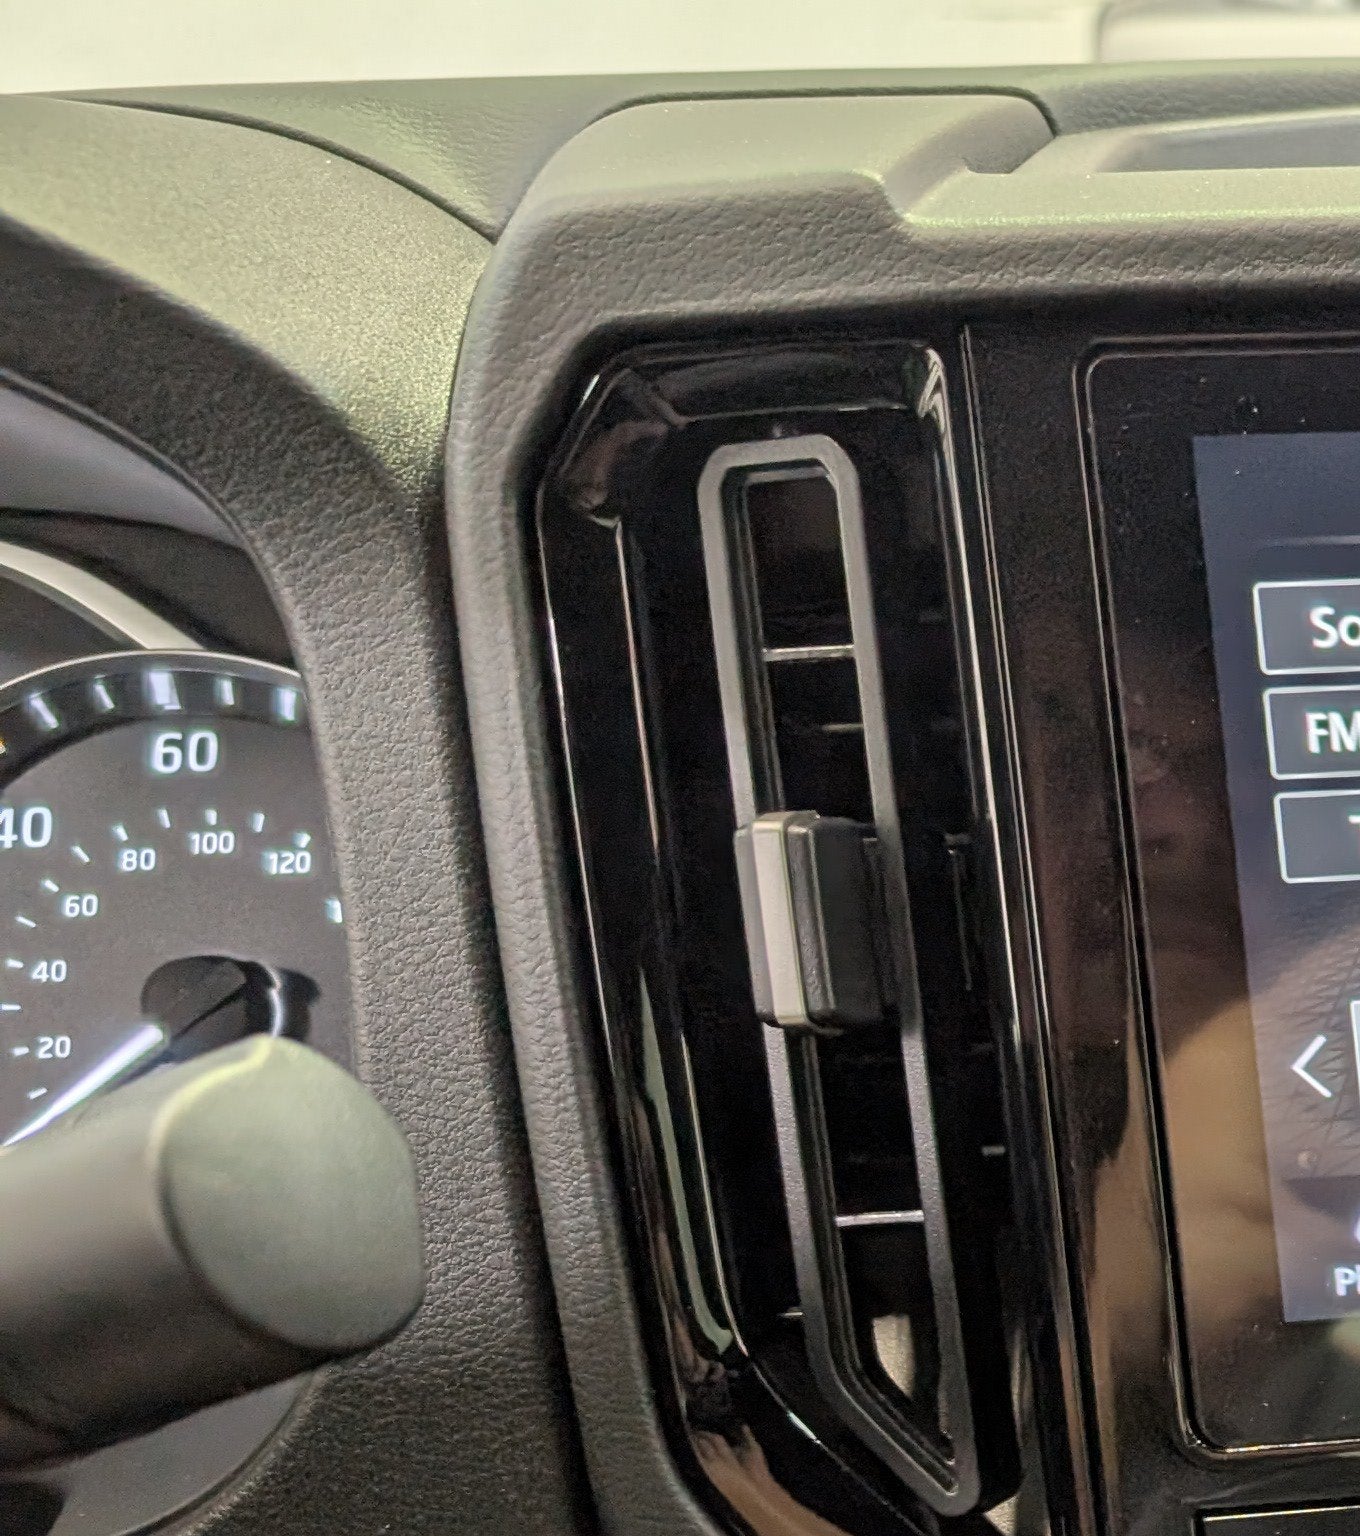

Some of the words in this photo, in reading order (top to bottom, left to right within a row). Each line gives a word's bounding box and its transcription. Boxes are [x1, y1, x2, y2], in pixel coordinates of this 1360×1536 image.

[152, 730, 219, 773] 60
[189, 832, 234, 855] 100
[121, 848, 155, 872] 80
[268, 851, 311, 874] 120
[64, 894, 98, 917] 60
[32, 960, 67, 982] 40
[37, 1037, 71, 1059] 20
